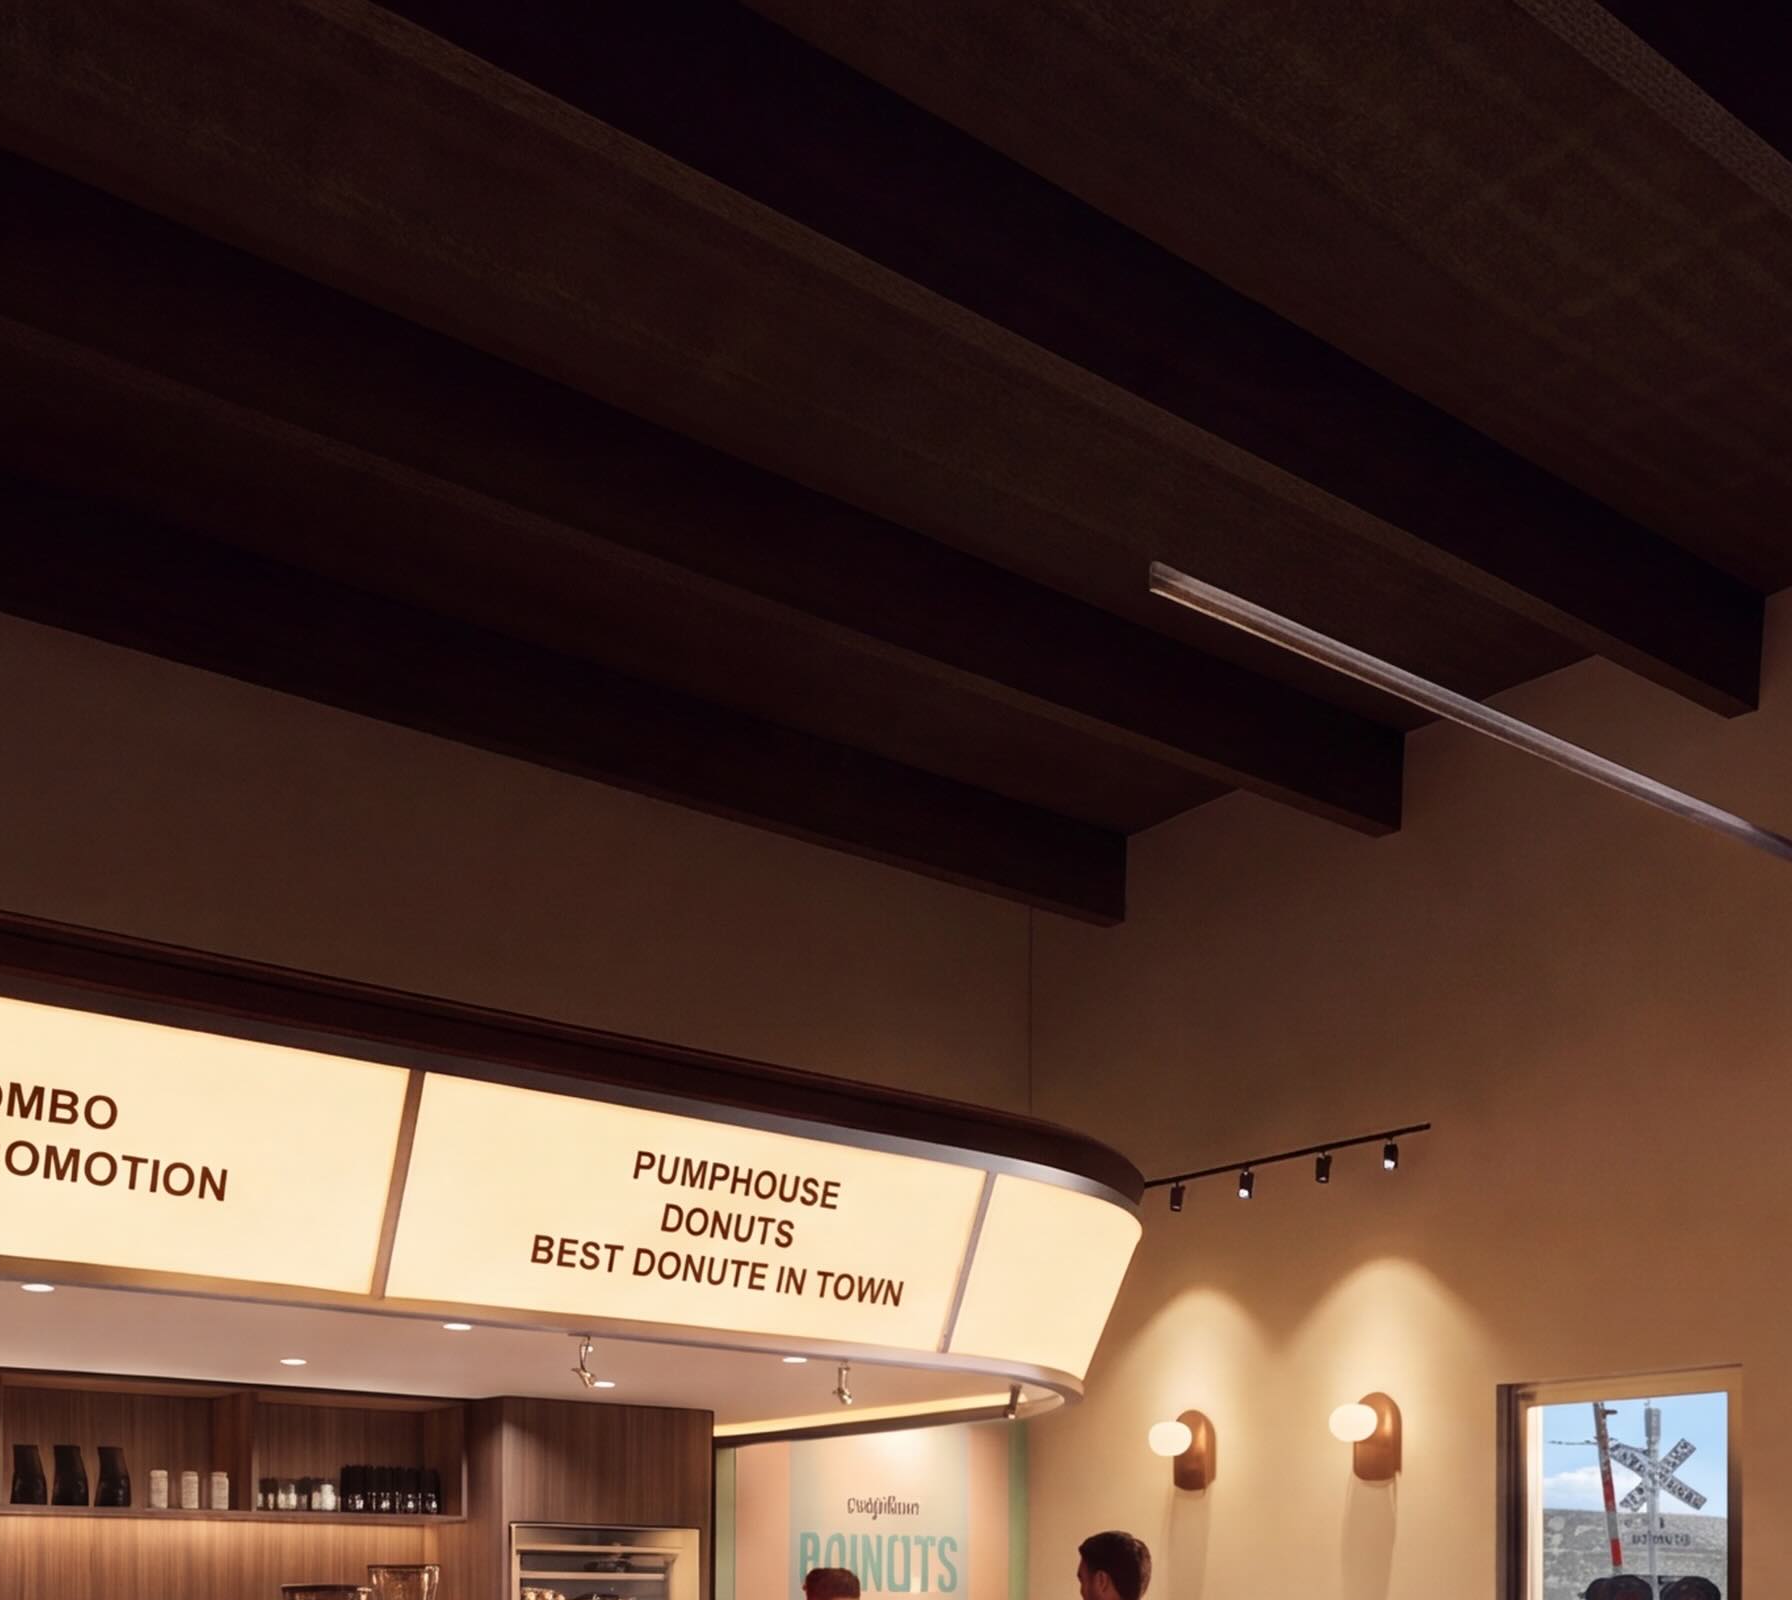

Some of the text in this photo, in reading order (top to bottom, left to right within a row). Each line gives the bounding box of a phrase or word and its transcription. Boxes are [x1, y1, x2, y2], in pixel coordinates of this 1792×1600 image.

[632, 1150, 841, 1210] PUMPHOUSE
[660, 1203, 795, 1249] DONUTS
[530, 1234, 904, 1307] BEST DONUTE IN TOWN
